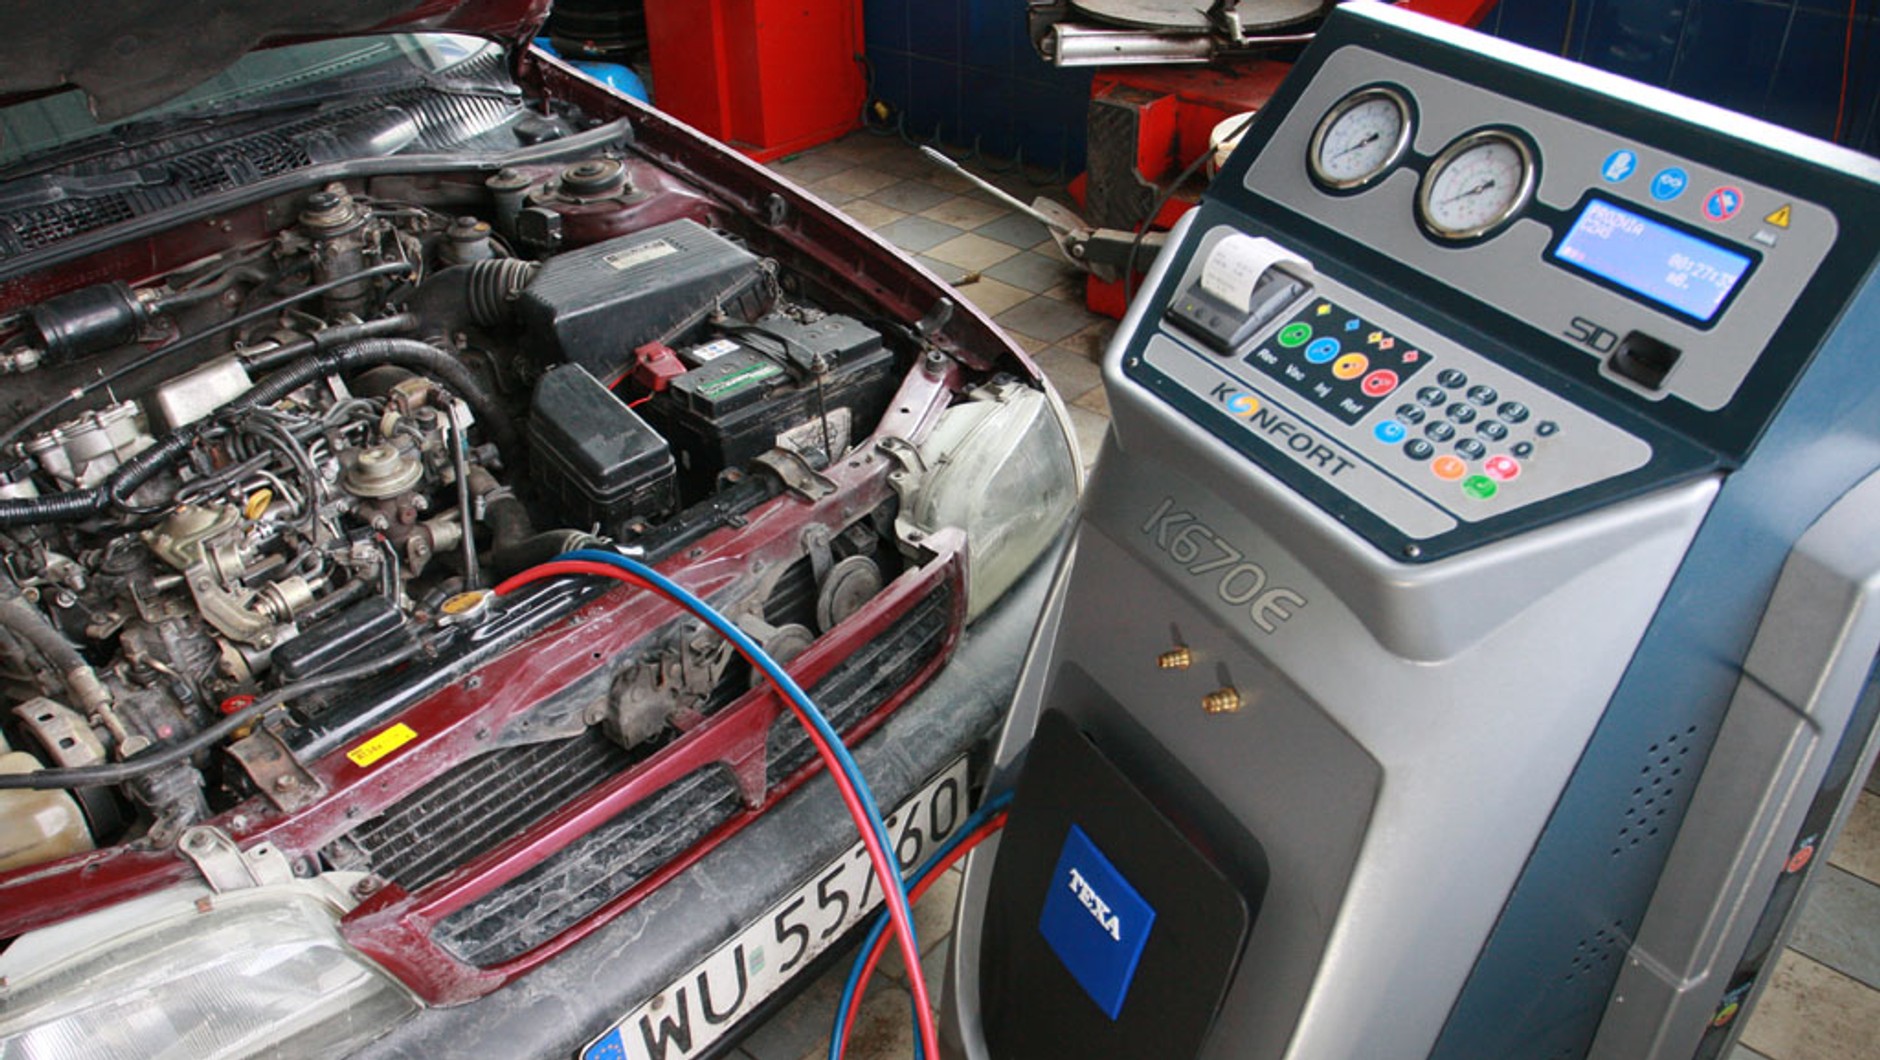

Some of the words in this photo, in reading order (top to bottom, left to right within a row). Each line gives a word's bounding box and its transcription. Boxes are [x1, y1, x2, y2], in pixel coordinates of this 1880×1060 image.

[1563, 316, 1618, 353] SD
[1210, 382, 1356, 476] KONFORT
[1141, 496, 1308, 635] K670E
[1068, 867, 1120, 941] TEXA
[639, 944, 748, 1060] WU
